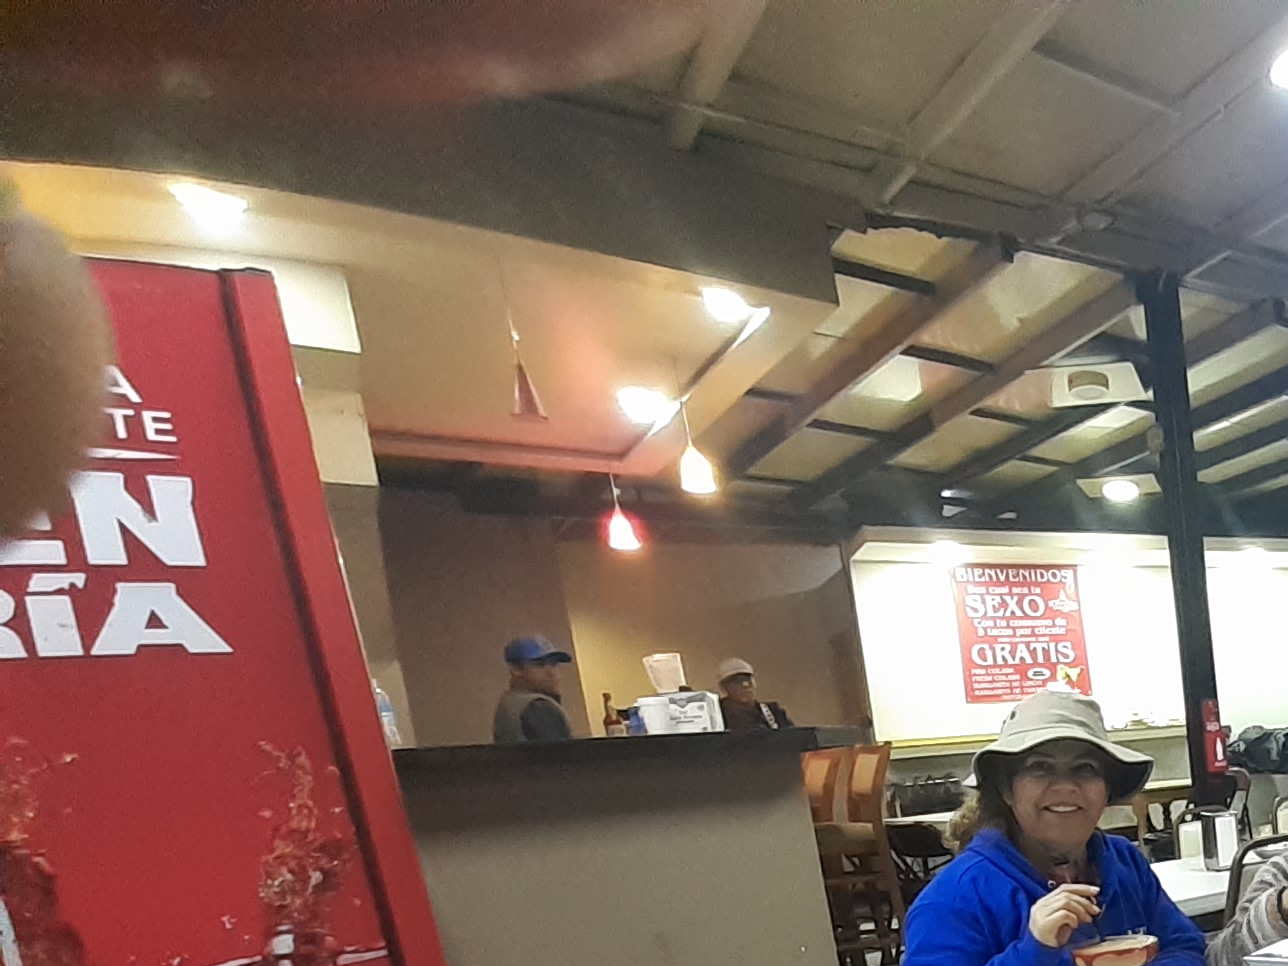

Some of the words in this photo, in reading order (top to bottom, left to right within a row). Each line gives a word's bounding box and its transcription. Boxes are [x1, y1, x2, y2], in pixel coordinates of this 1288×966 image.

[955, 568, 1070, 582] BIENVENIDOS
[965, 595, 1045, 618] SEXO
[971, 641, 1075, 665] GRATIS
